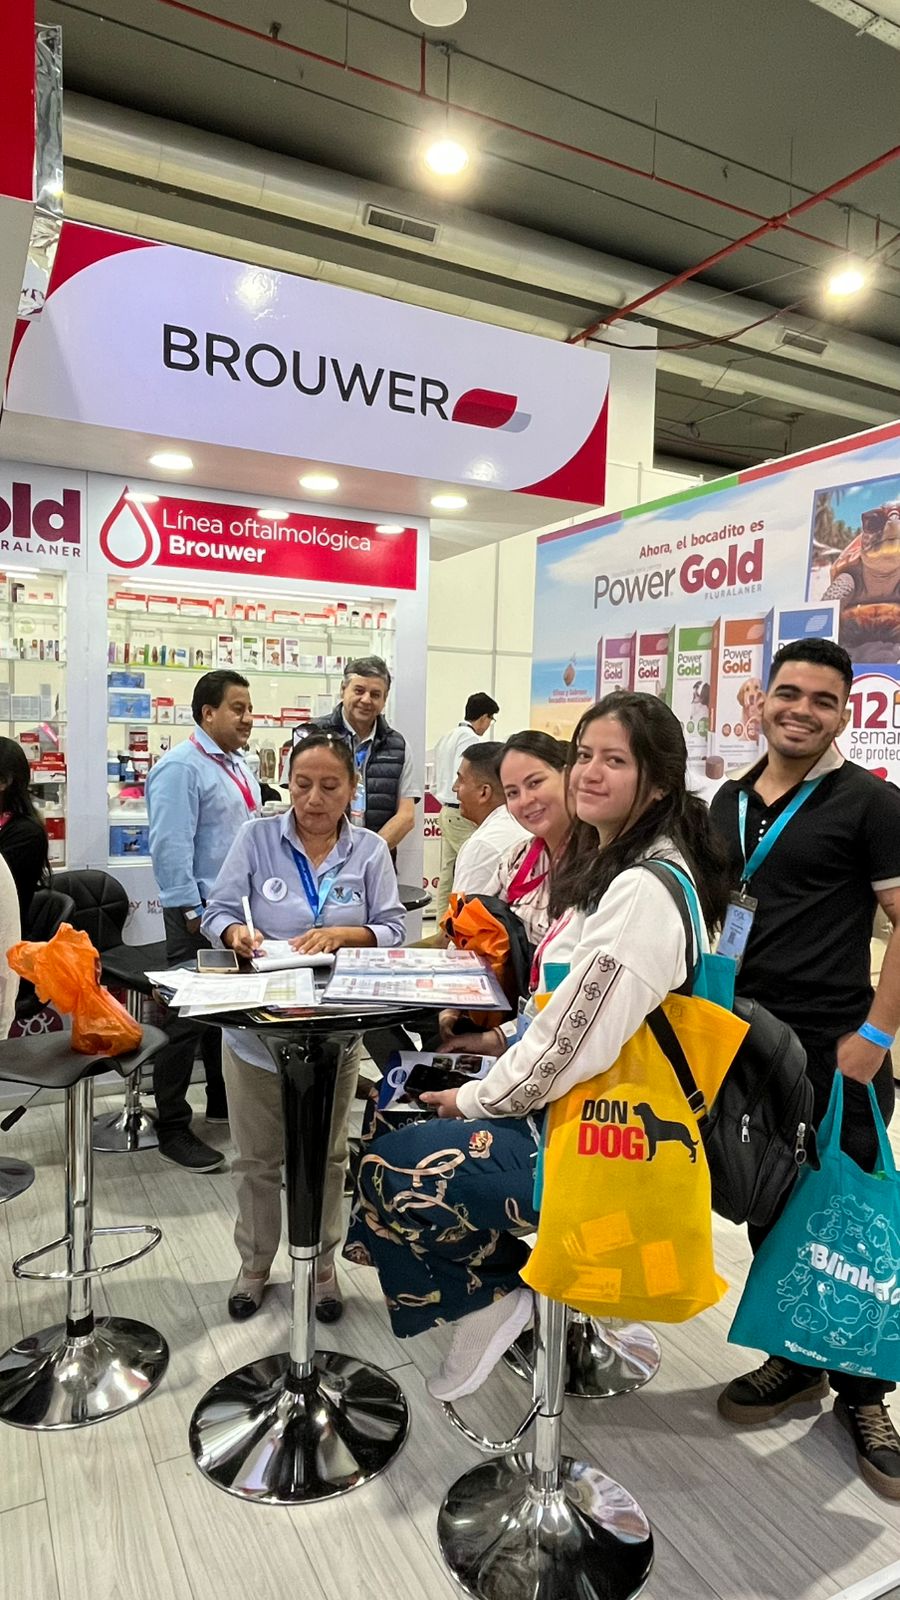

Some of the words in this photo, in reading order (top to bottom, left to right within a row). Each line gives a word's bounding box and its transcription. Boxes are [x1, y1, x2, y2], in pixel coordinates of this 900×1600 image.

[162, 323, 450, 421] BROUWER
[0, 482, 81, 544] ld
[163, 508, 223, 535] Línea
[229, 518, 371, 551] oftalmológica
[639, 543, 672, 559] Ahora,
[676, 536, 687, 550] el
[691, 524, 745, 545] bocadito
[750, 520, 764, 532] es
[169, 535, 266, 564] Brouwer
[594, 567, 676, 609] Power
[680, 538, 764, 594] Gold
[704, 584, 762, 600] FLURALANER
[639, 658, 660, 668] Power
[677, 653, 702, 664] Power
[722, 648, 752, 660] Power
[604, 669, 623, 680] Gold
[638, 667, 660, 679] Gold
[677, 663, 702, 677] Gold
[722, 658, 751, 674] Gold
[849, 691, 888, 729] 12
[849, 745, 863, 760] de
[581, 1099, 628, 1124] DON
[577, 1122, 644, 1161] DOG
